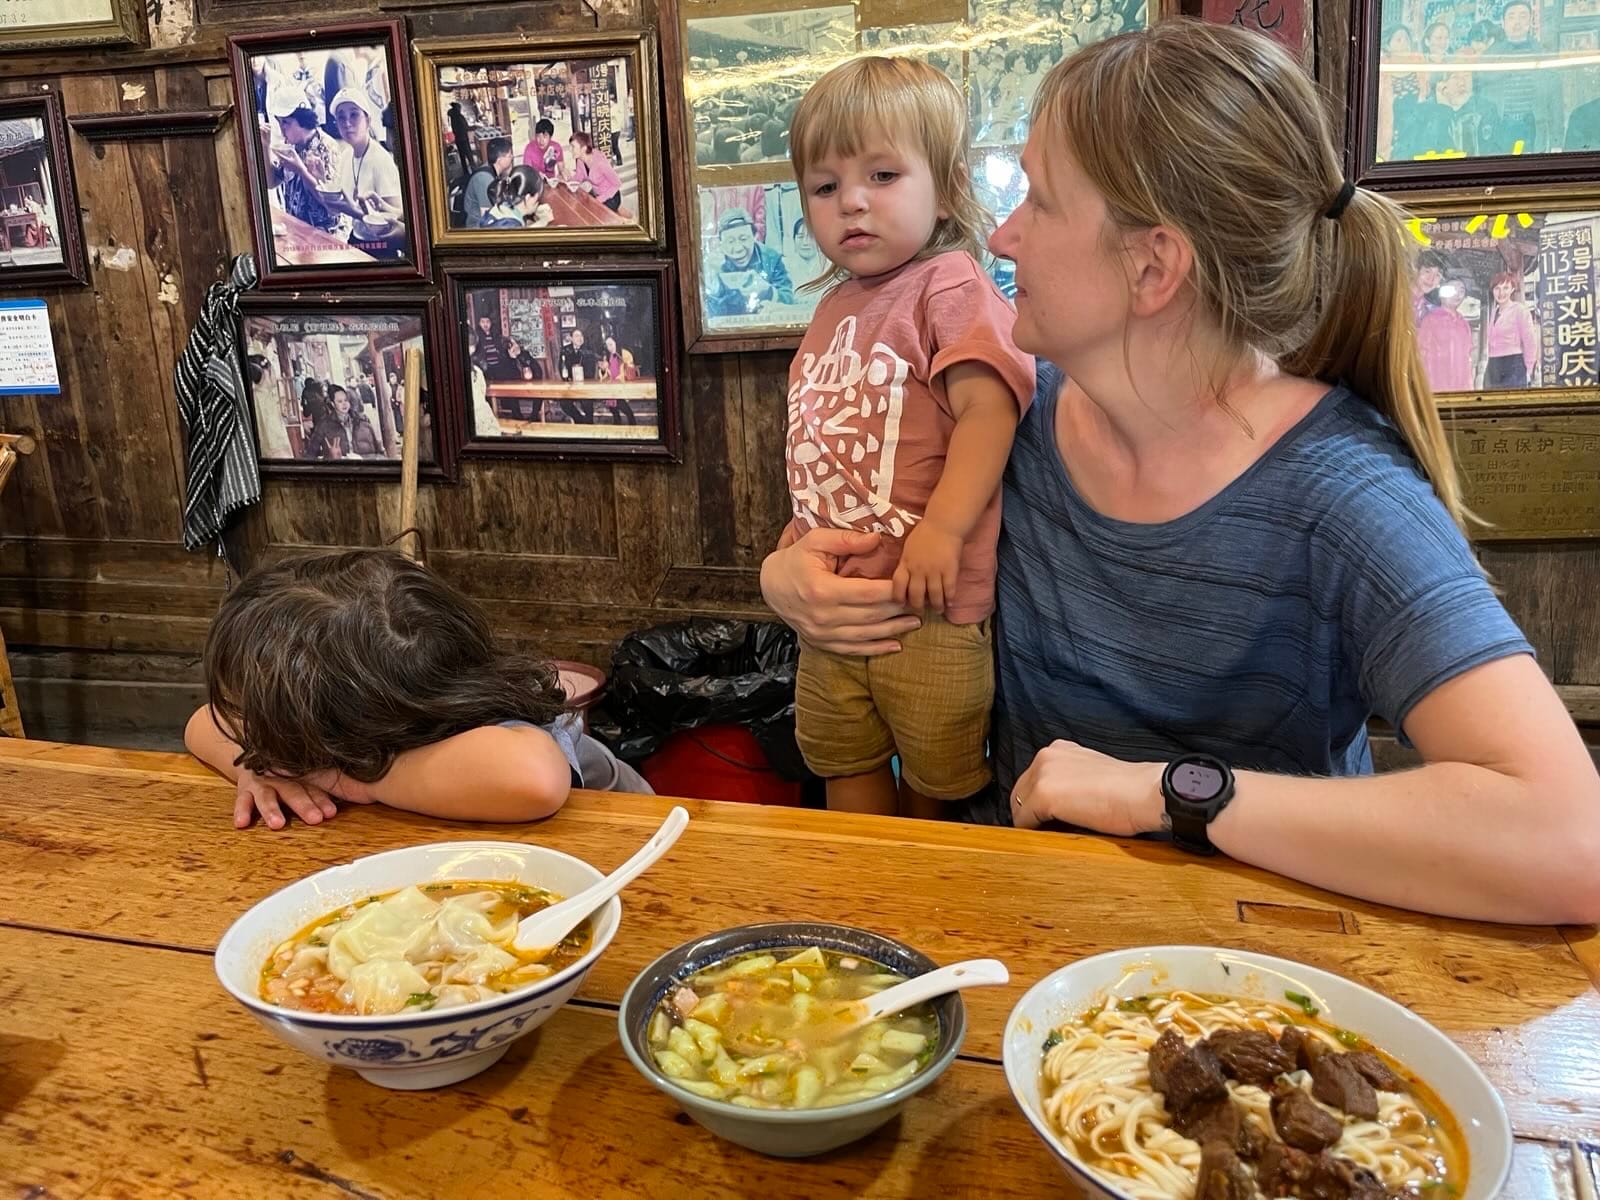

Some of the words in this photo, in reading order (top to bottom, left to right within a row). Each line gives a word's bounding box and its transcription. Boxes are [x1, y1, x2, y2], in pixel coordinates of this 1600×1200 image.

[1540, 227, 1592, 251] 芙蓉镇
[1541, 247, 1592, 275] 113号
[1546, 273, 1589, 295] 正宗
[1470, 436, 1597, 454] 重点保护民居
